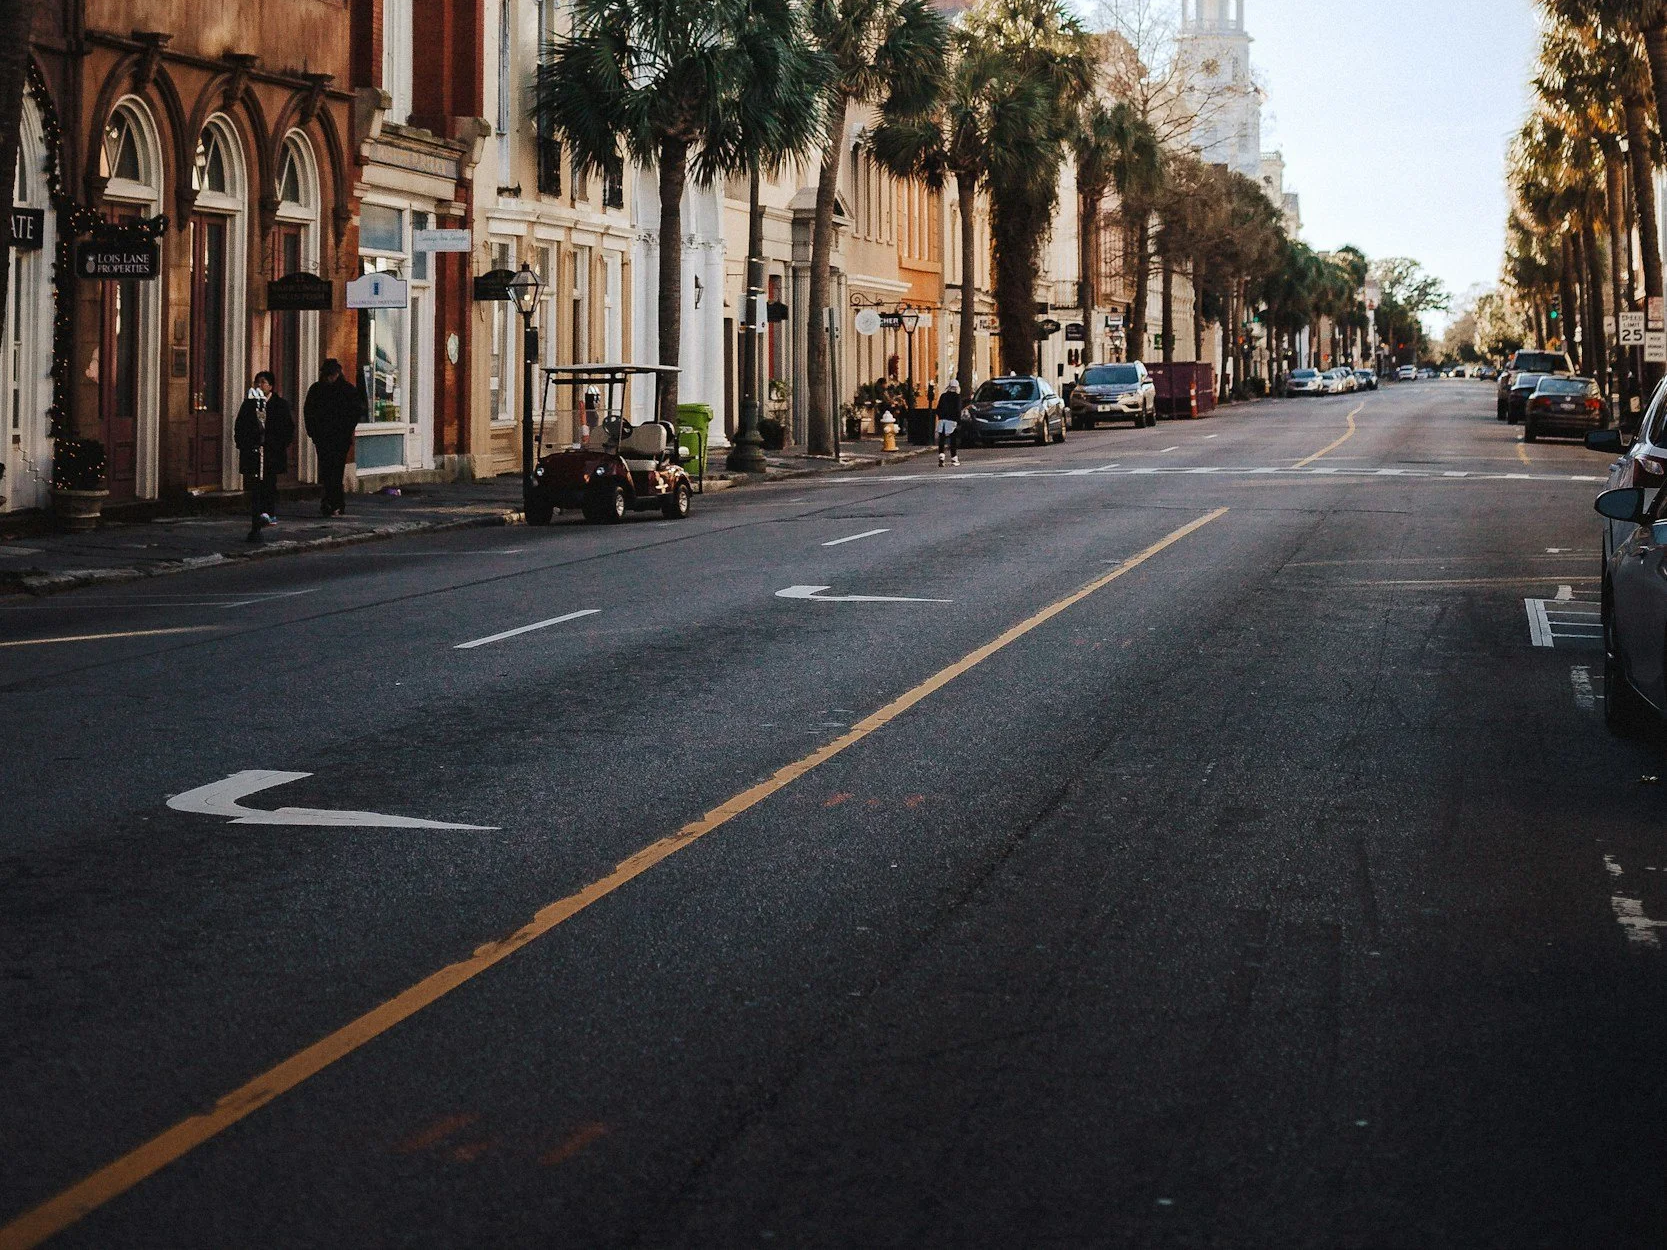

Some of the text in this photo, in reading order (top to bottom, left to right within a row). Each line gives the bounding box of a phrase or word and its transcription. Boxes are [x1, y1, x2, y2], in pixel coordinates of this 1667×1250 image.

[97, 253, 150, 264] LOIS LANE
[97, 264, 150, 274] PROPERTIES
[1622, 329, 1643, 341] 25
